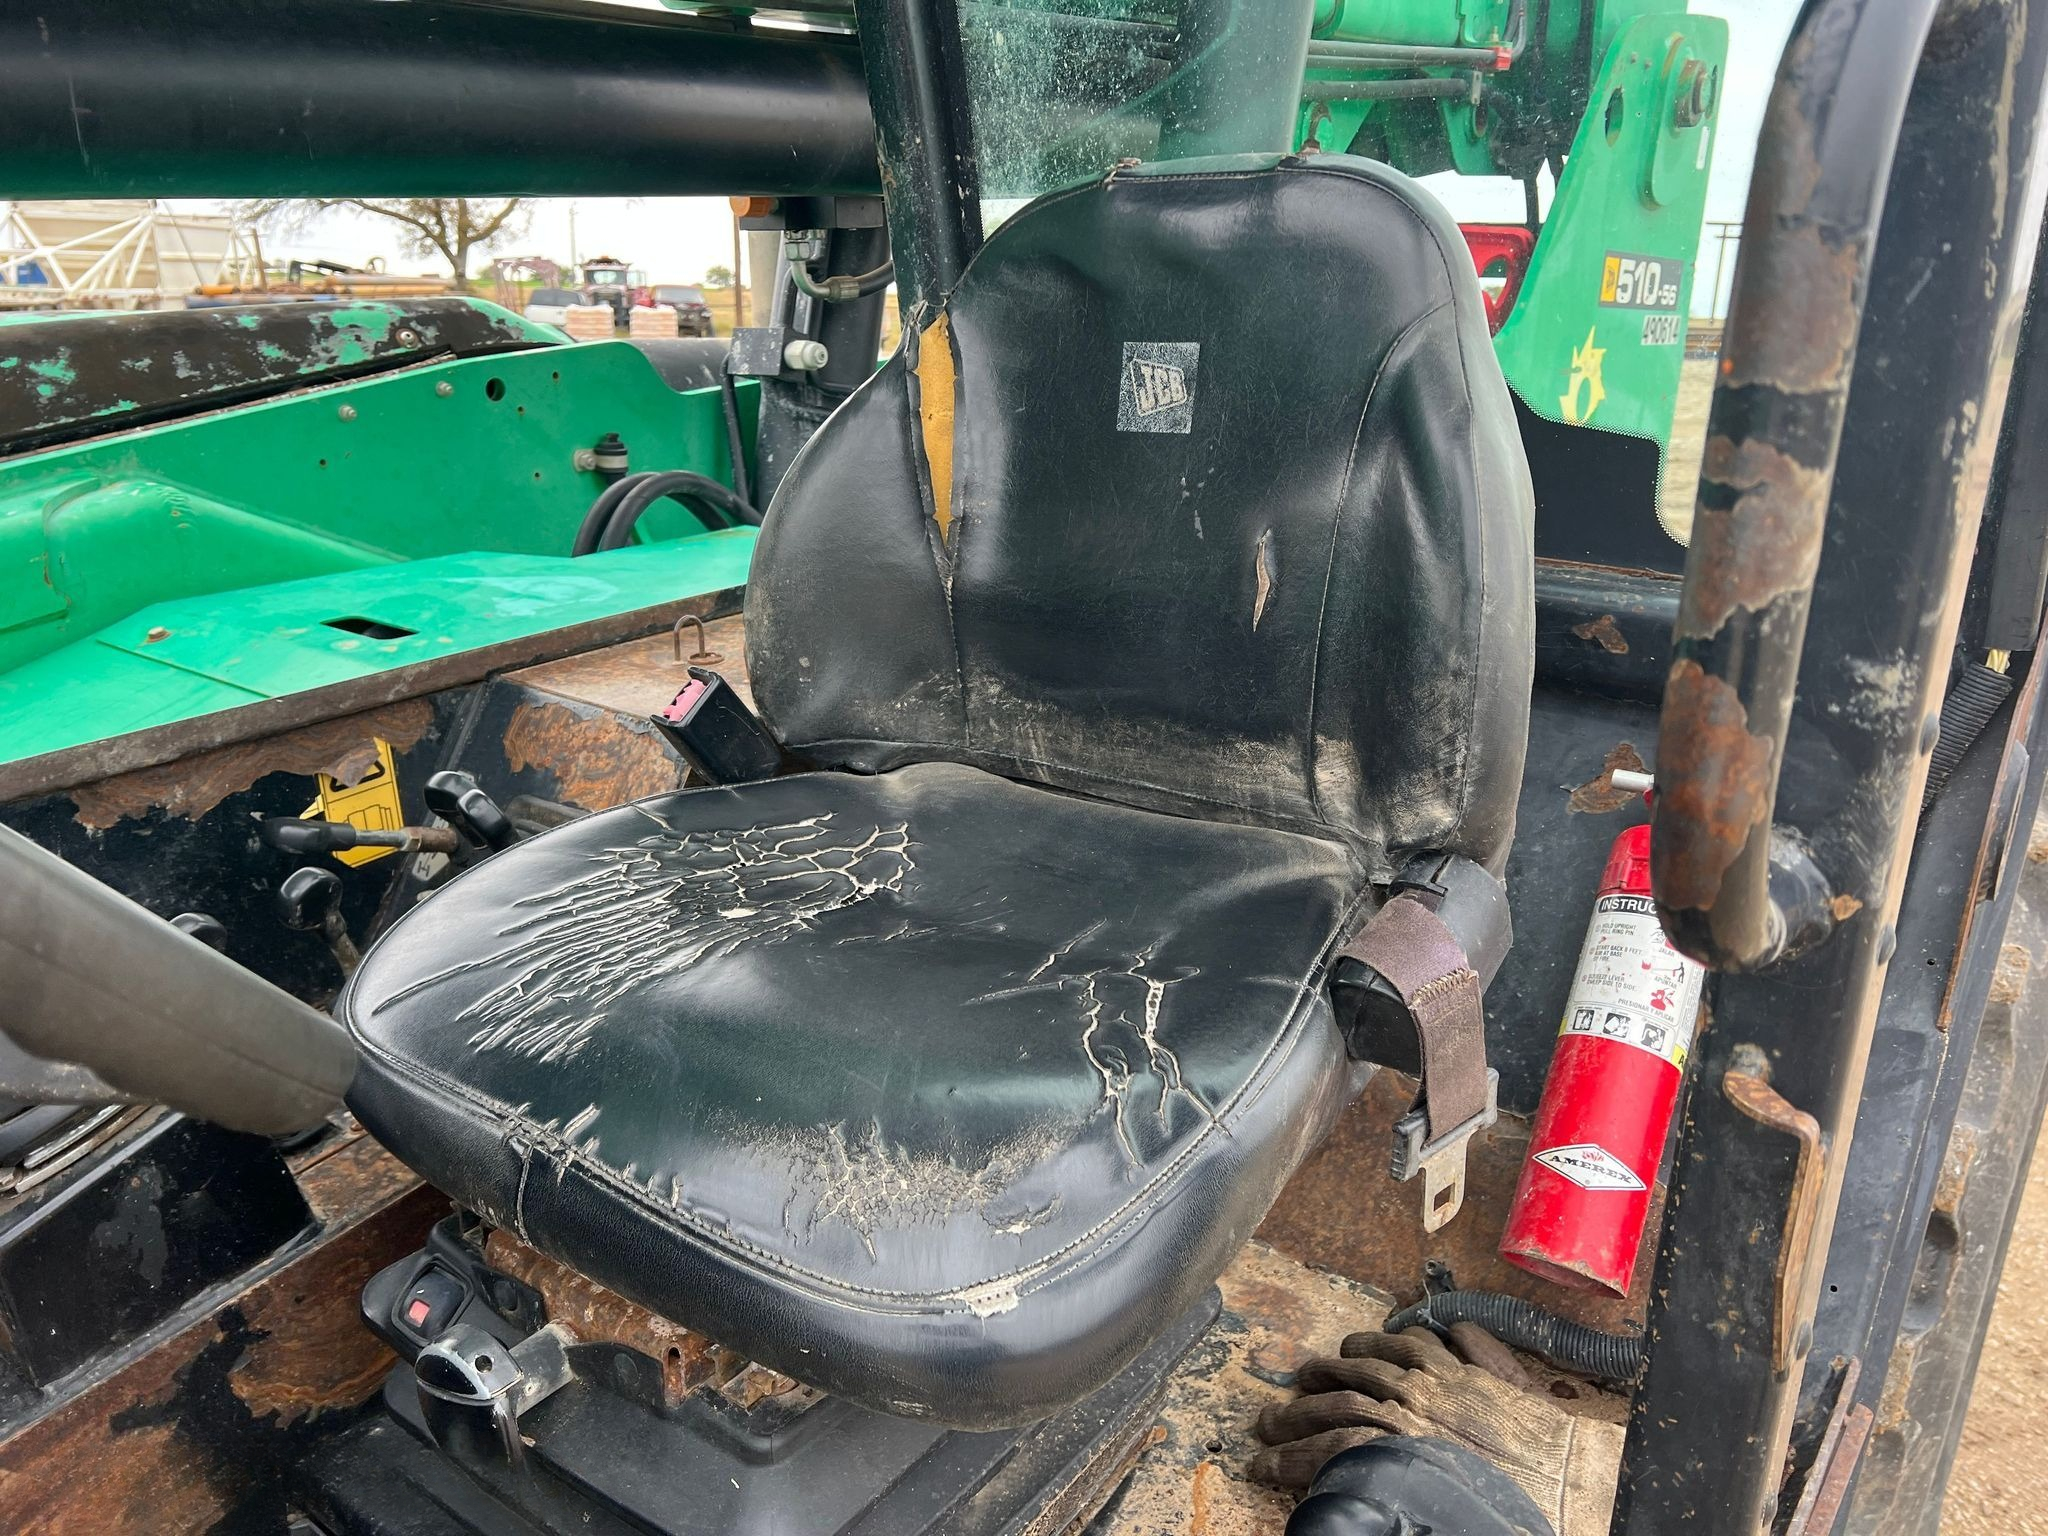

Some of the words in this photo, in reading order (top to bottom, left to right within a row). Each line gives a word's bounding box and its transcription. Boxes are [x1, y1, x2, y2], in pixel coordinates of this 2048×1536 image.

[1139, 364, 1184, 411] JCB
[1608, 974, 1625, 982] LEVER
[1618, 998, 1649, 1012] PRESIONAR
[1549, 1155, 1632, 1184] AMEREX
